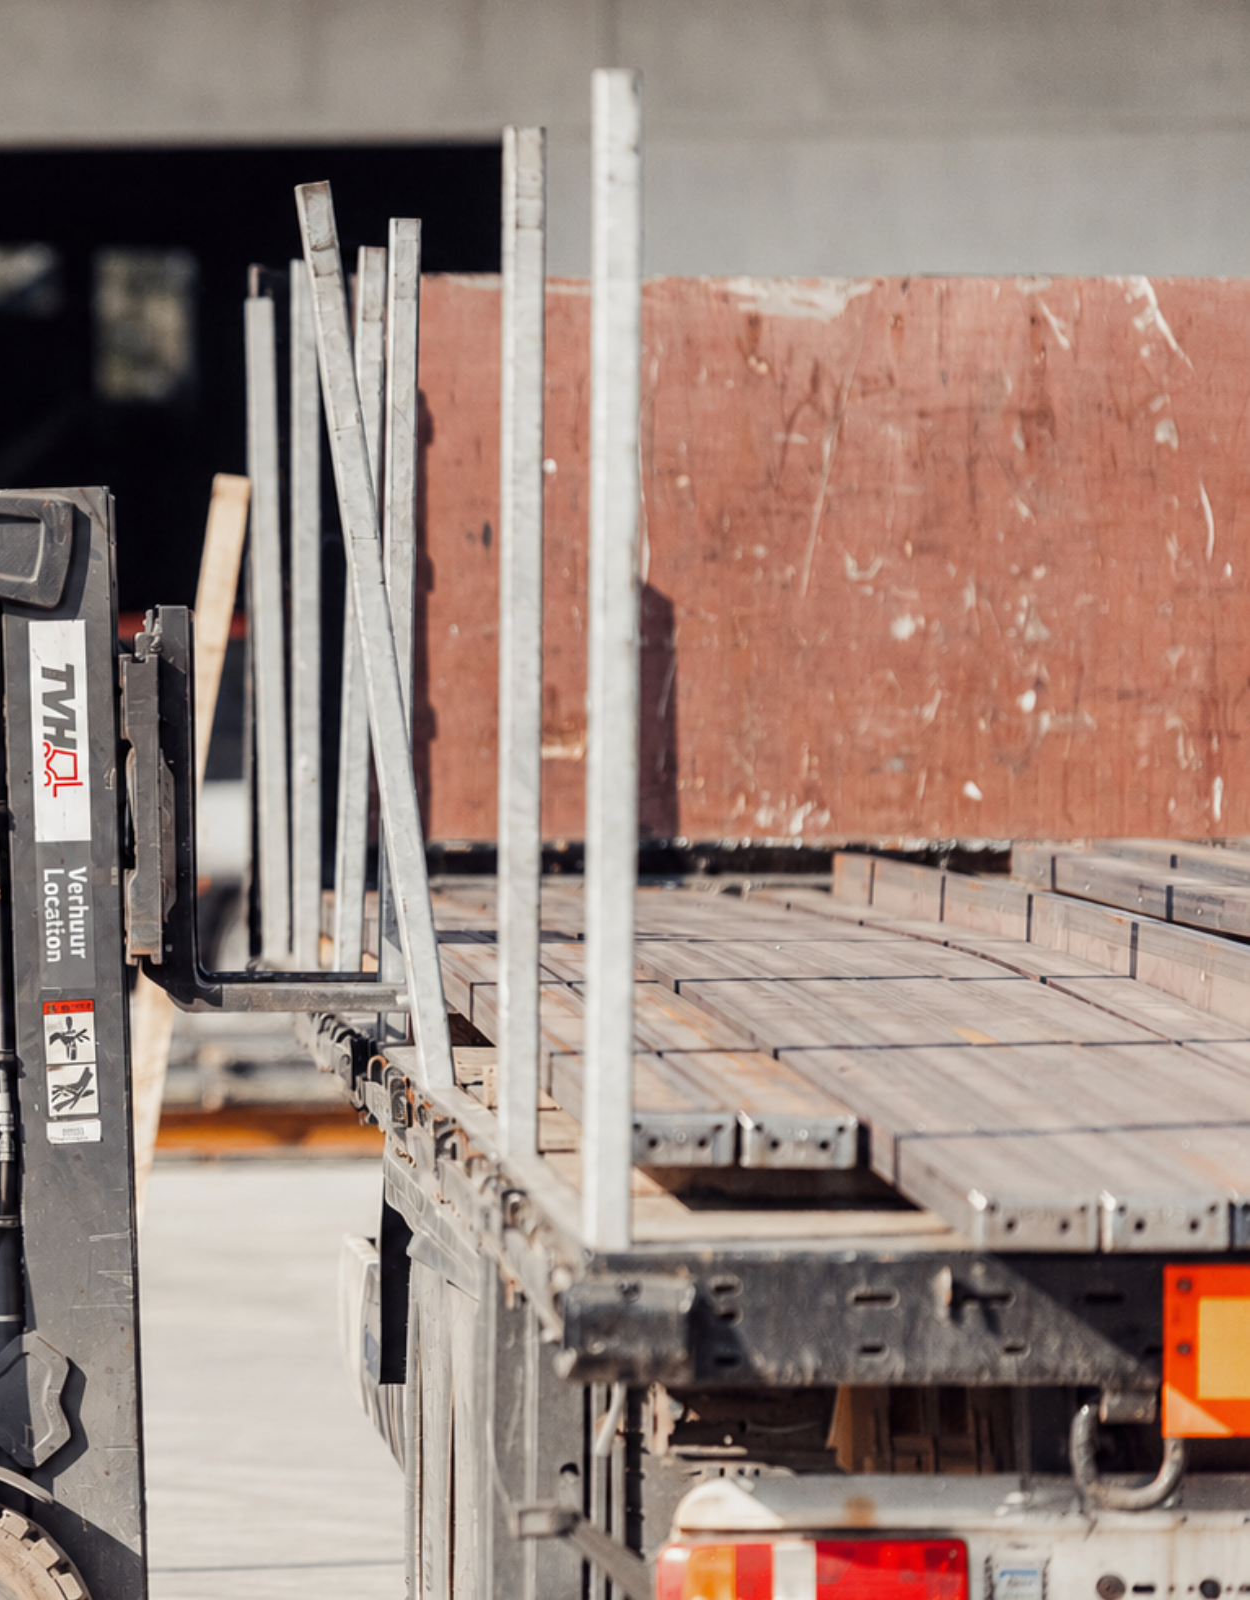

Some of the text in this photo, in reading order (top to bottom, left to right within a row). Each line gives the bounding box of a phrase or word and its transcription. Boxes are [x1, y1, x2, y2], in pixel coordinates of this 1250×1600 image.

[41, 663, 77, 750] TVH
[43, 868, 65, 962] Location
[67, 866, 89, 958] Verhuur
